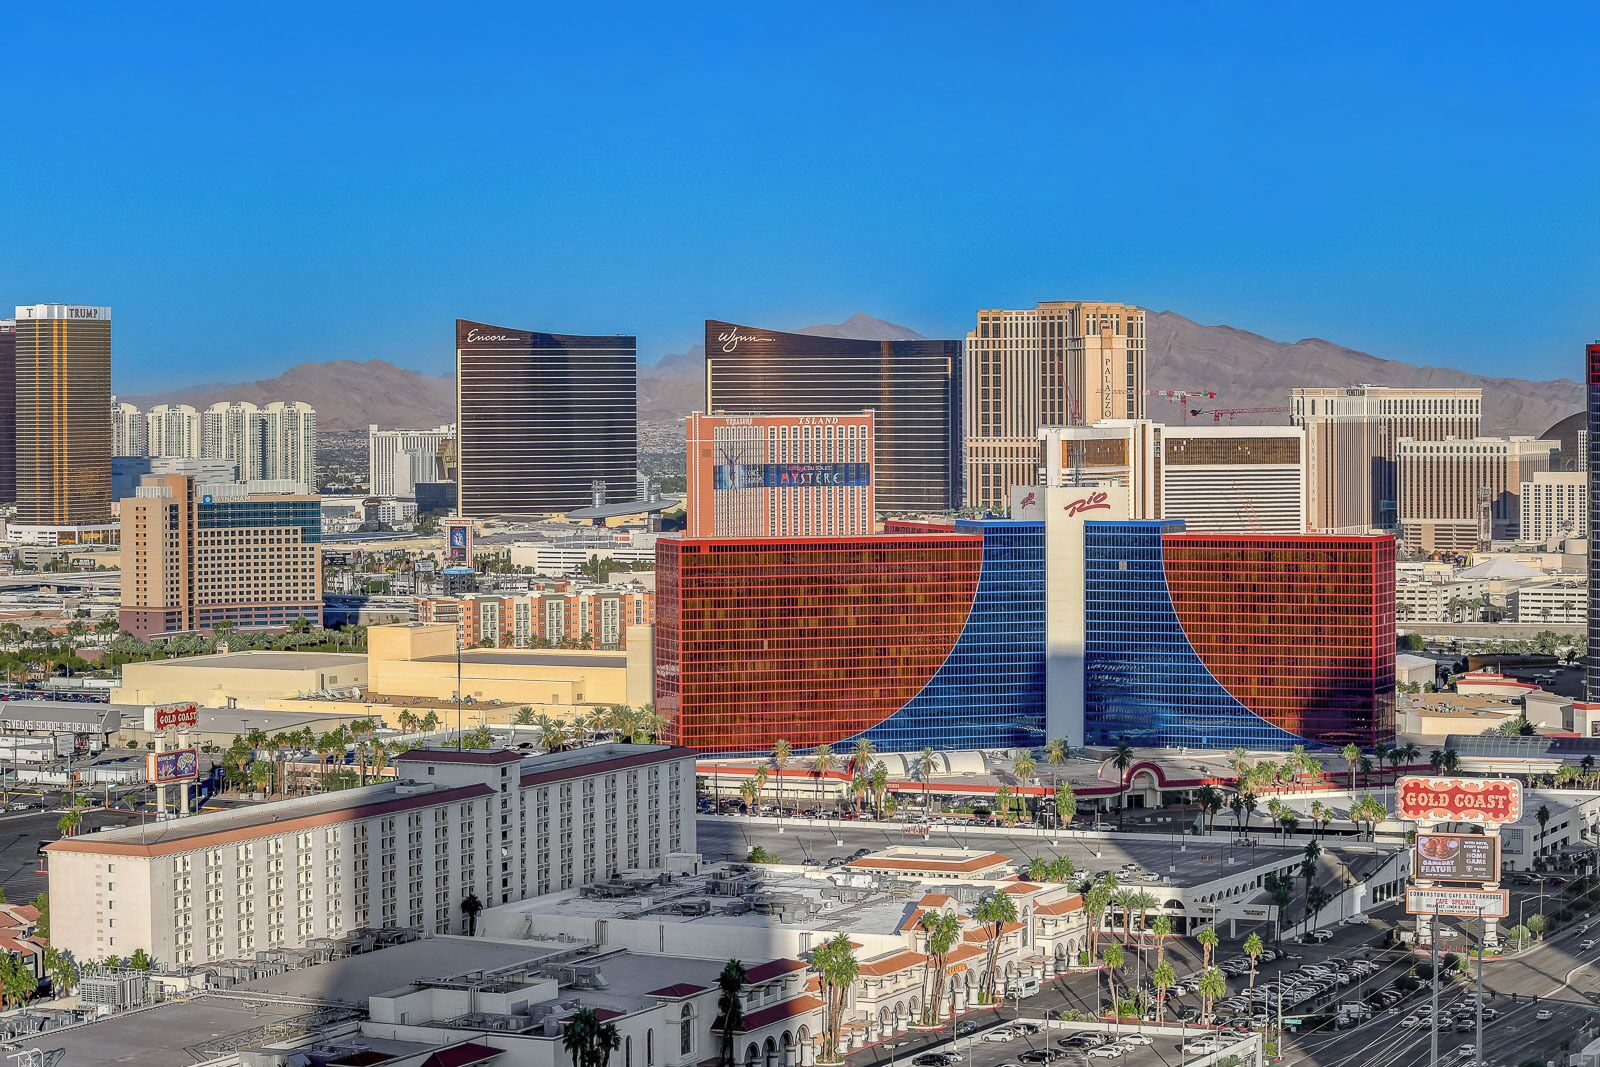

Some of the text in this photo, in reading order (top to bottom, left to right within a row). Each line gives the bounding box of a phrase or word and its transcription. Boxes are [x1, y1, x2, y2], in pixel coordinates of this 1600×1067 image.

[69, 308, 98, 318] TRUMP
[467, 328, 520, 343] Encore
[1104, 358, 1112, 418] PALAZZO
[1346, 389, 1366, 397] VENETIAN
[726, 417, 839, 426] TREASURE ISLAND
[213, 495, 251, 503] WYNDHAM
[160, 711, 197, 725] GOLD COAST
[11, 719, 33, 730] VEGAS
[72, 722, 101, 733] DEALING
[1406, 793, 1506, 808] GOLD COAST
